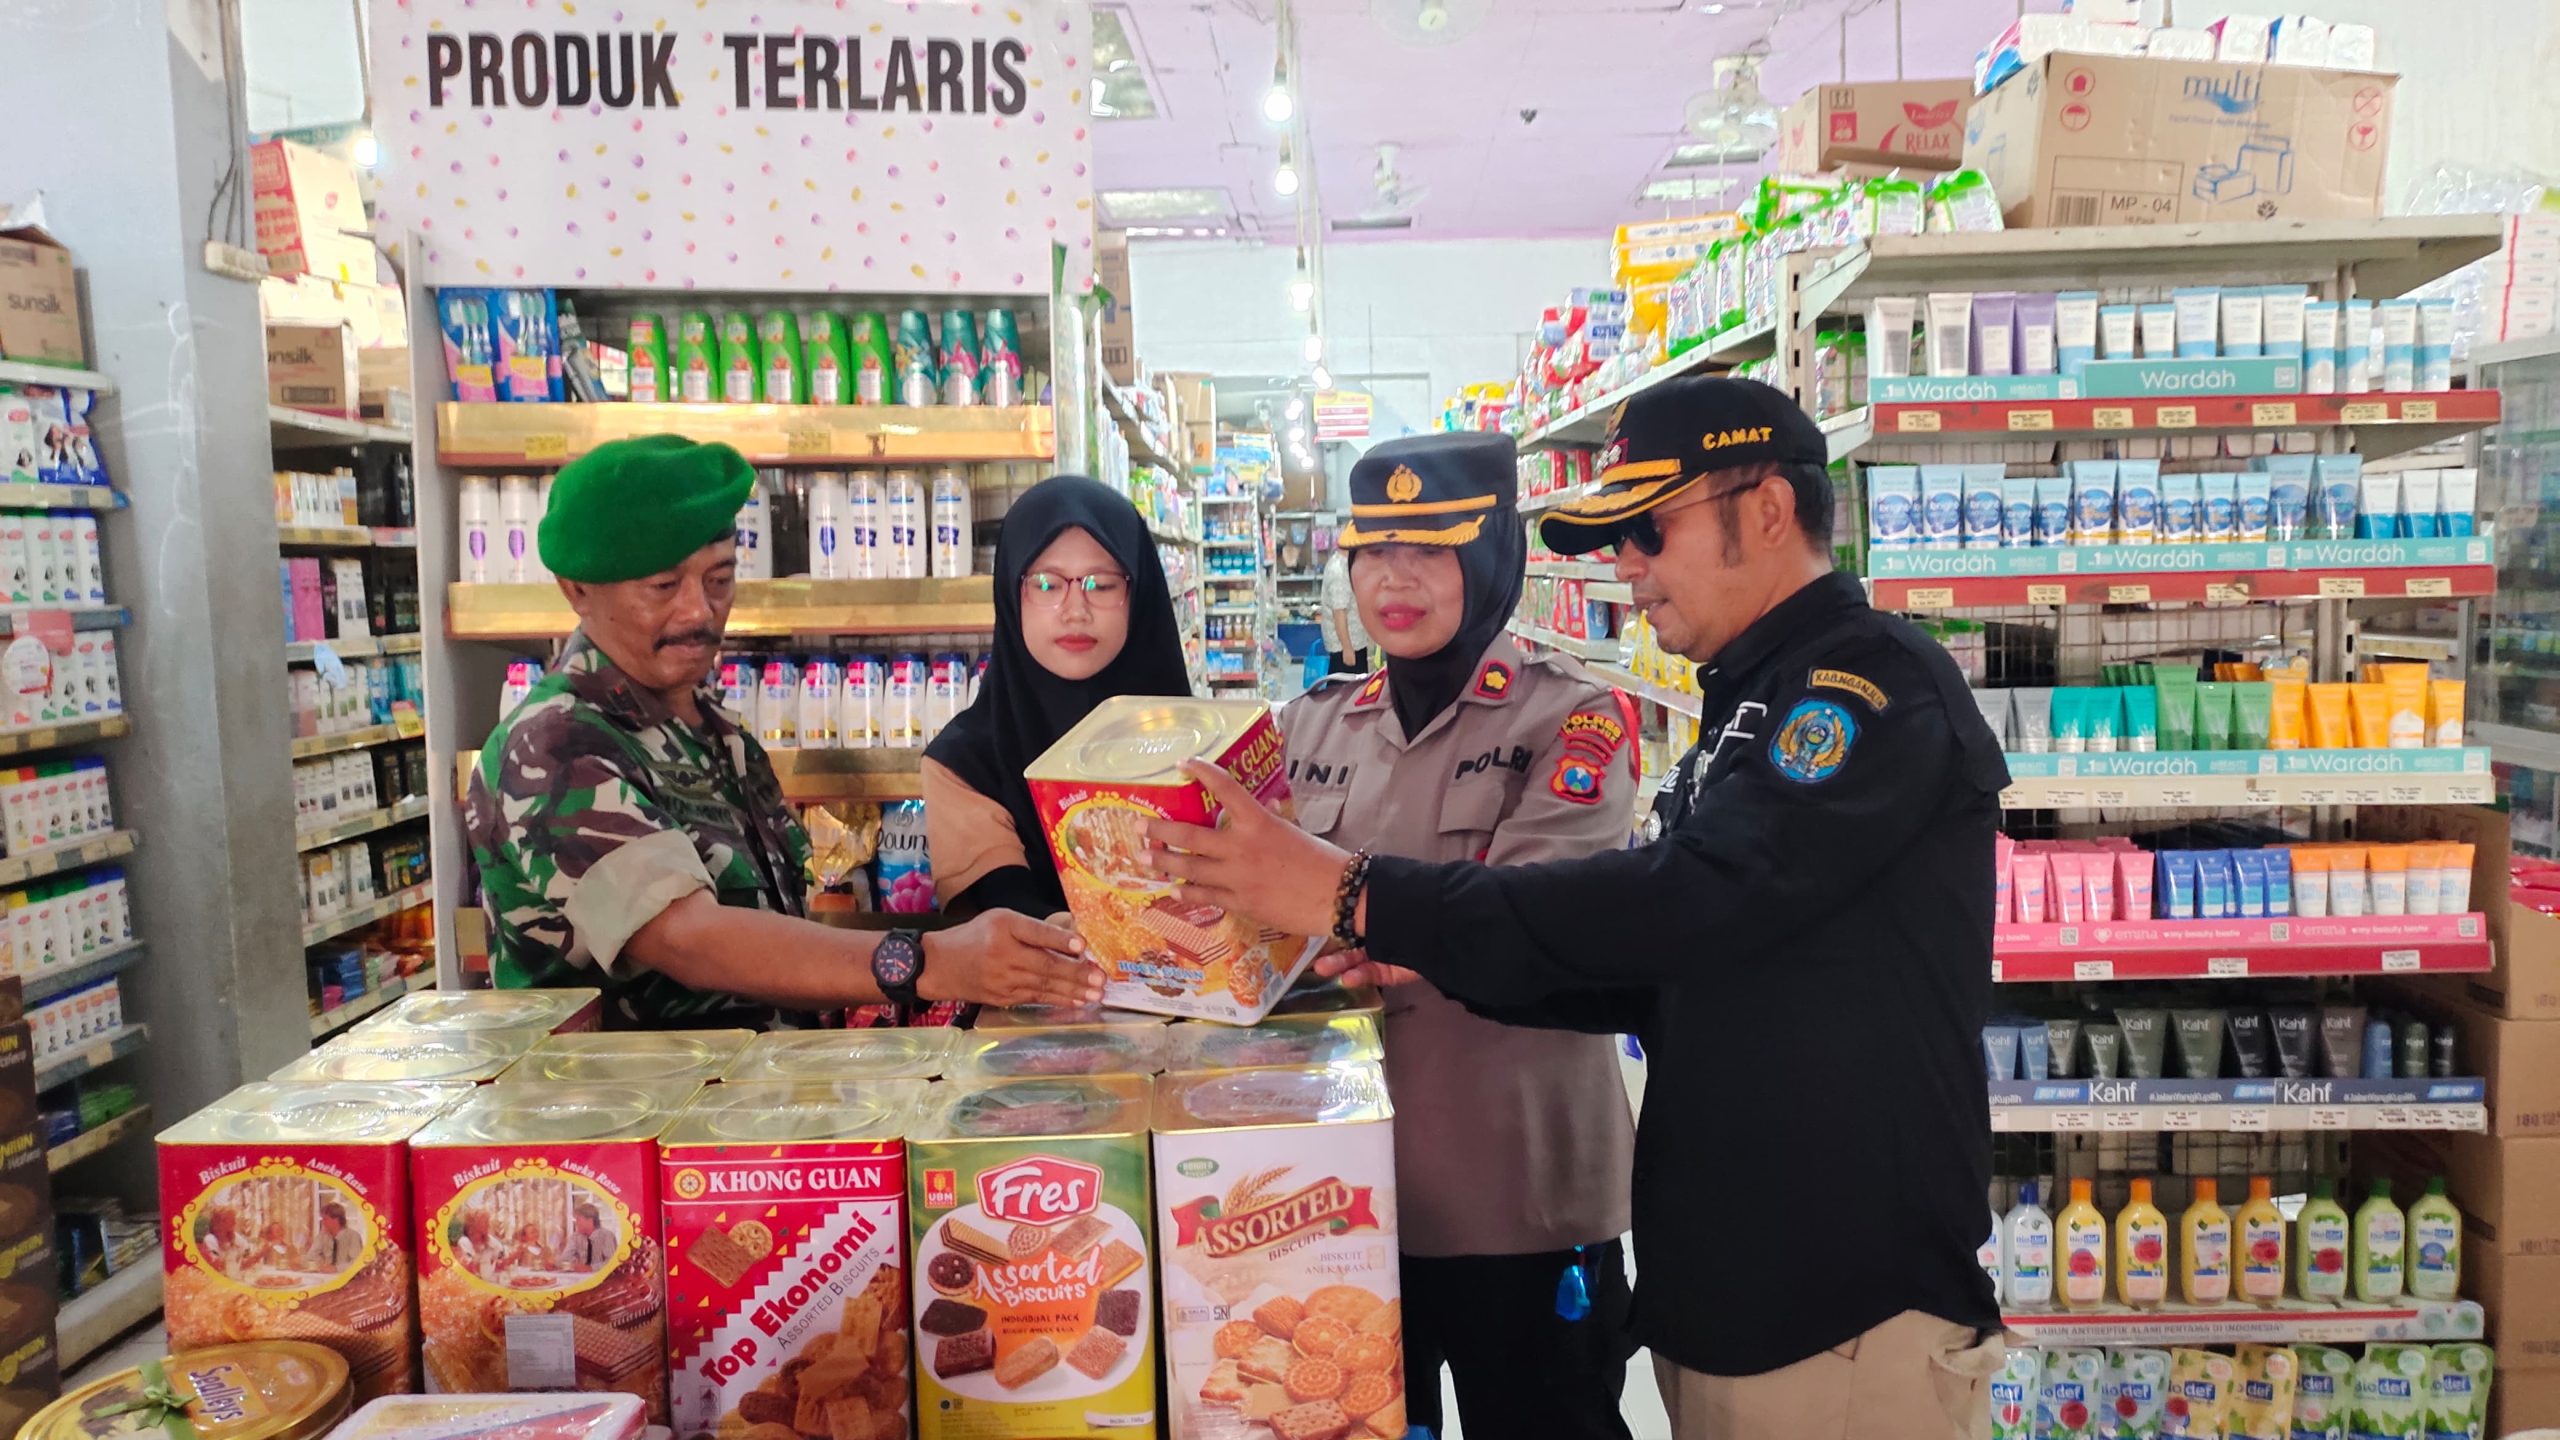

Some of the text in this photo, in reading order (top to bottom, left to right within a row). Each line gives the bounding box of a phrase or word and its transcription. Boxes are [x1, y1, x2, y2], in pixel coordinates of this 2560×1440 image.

[427, 33, 1028, 114] PRODUK TERLARIS
[1905, 133, 1951, 152] RELAX
[2109, 195, 2137, 212] MP
[2153, 198, 2172, 213] 04
[7, 292, 64, 314] sunsilk
[1701, 426, 1774, 451] CAMAT
[1455, 745, 1534, 780] POLRI
[2125, 1018, 2152, 1031] Kahf
[2182, 1019, 2210, 1032] Kahf
[2234, 1015, 2259, 1029] Kahf
[2278, 1017, 2308, 1031] Kahf
[2326, 1015, 2352, 1030] Kahf
[2048, 1029, 2071, 1041] Kahf
[2091, 1034, 2114, 1045] Kahf
[2088, 1082, 2138, 1103] Kahf
[2284, 1082, 2333, 1104] Kahf
[198, 1155, 248, 1185] Biskuit
[306, 1157, 369, 1195] Aneka Rasa
[452, 1157, 502, 1188] Biskuit
[560, 1157, 622, 1195] Aneka Rasa
[708, 1166, 882, 1194] KHONG GUAN
[928, 1192, 954, 1202] UBM
[990, 1166, 1087, 1216] Fres
[1194, 1180, 1355, 1257] ASSORTED
[1267, 1230, 1327, 1262] BISCUITS
[1319, 1250, 1363, 1262] BISKUIT
[974, 1245, 1104, 1305] Assorted
[1304, 1263, 1374, 1275] ANEKA RASA
[699, 1210, 879, 1388] Top Ekonomi
[776, 1246, 880, 1351] ASSORTED BISCUITS
[1055, 1312, 1080, 1322] PACK
